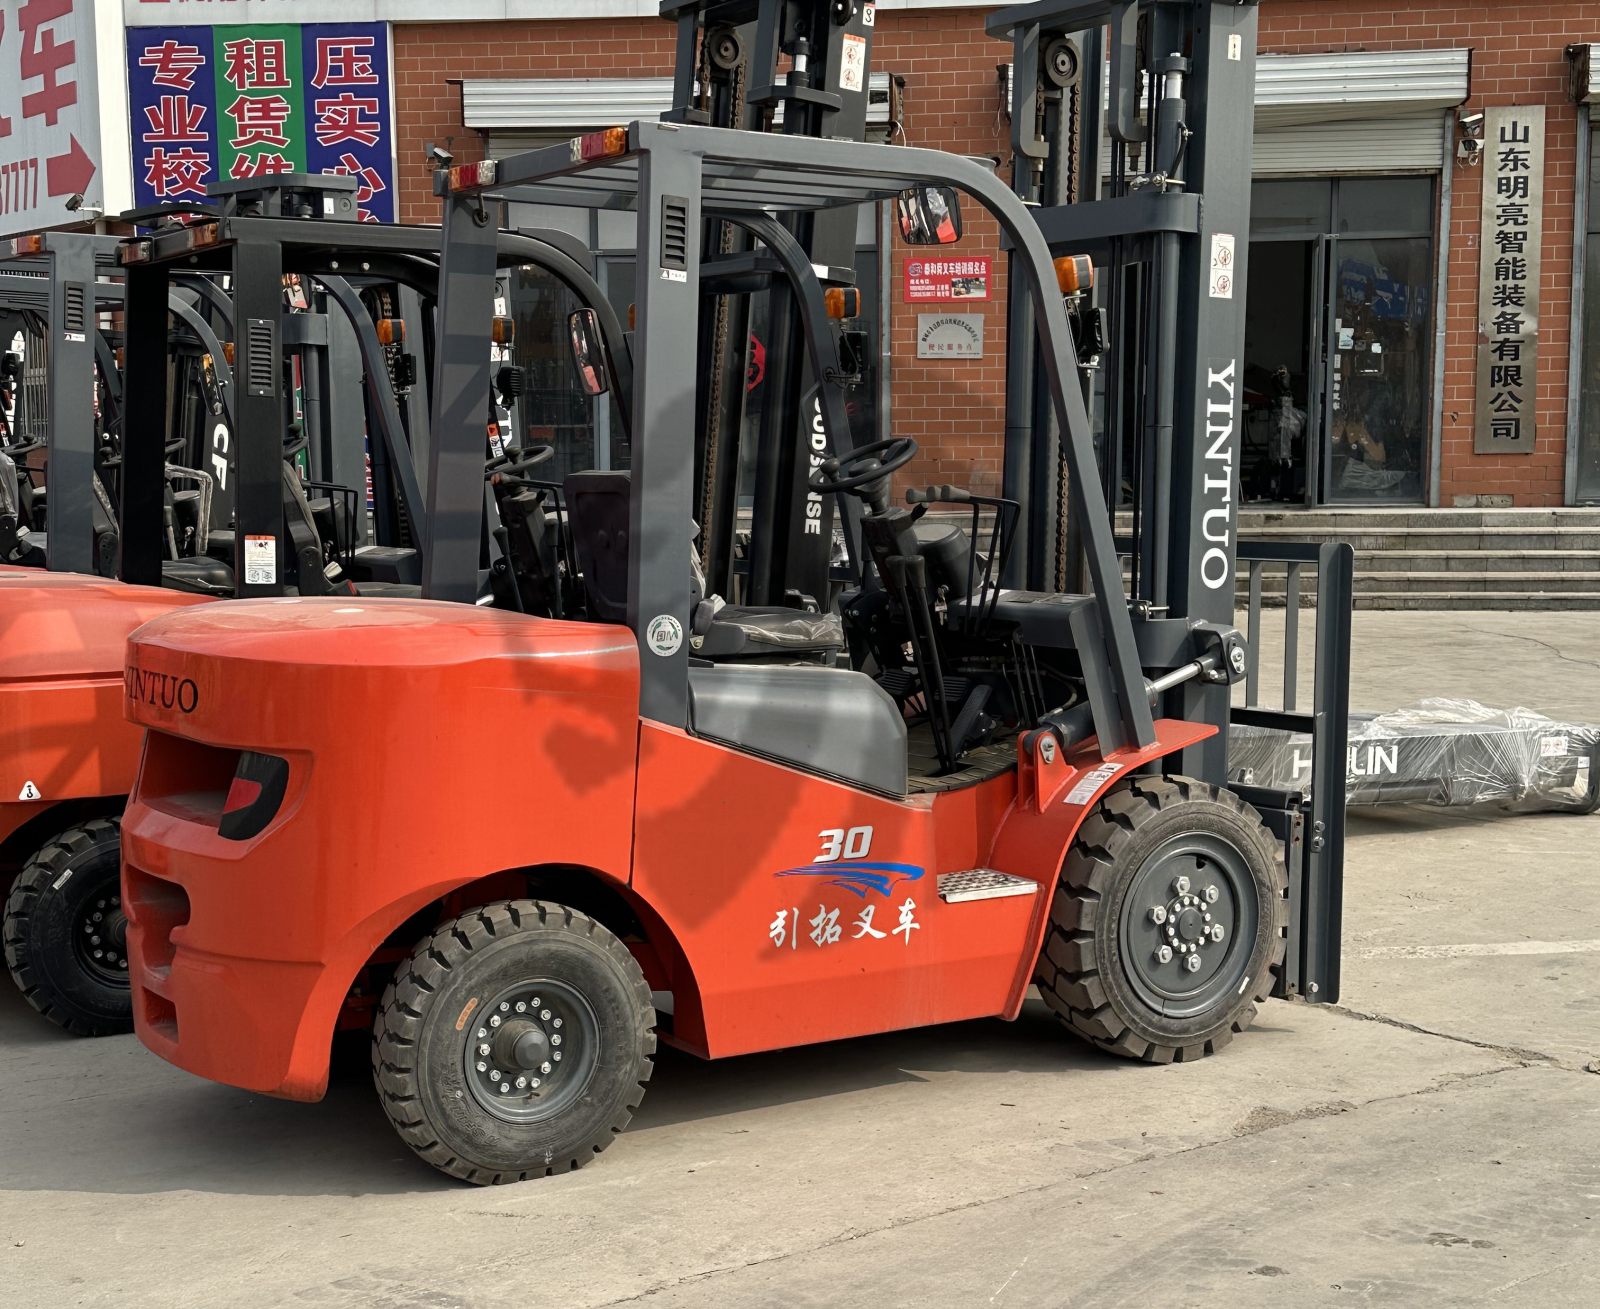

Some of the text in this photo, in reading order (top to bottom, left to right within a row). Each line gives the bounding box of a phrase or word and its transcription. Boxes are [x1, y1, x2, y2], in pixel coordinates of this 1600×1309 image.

[0, 158, 38, 216] 7777
[139, 40, 210, 224] 专业校
[311, 36, 386, 222] 压实心
[1489, 120, 1531, 440] 山东明亮智能装备有限公司
[1200, 358, 1236, 590] YINTUO
[127, 666, 199, 714] INTUO
[812, 825, 874, 863] 30
[768, 897, 922, 951] 引拓叉车
